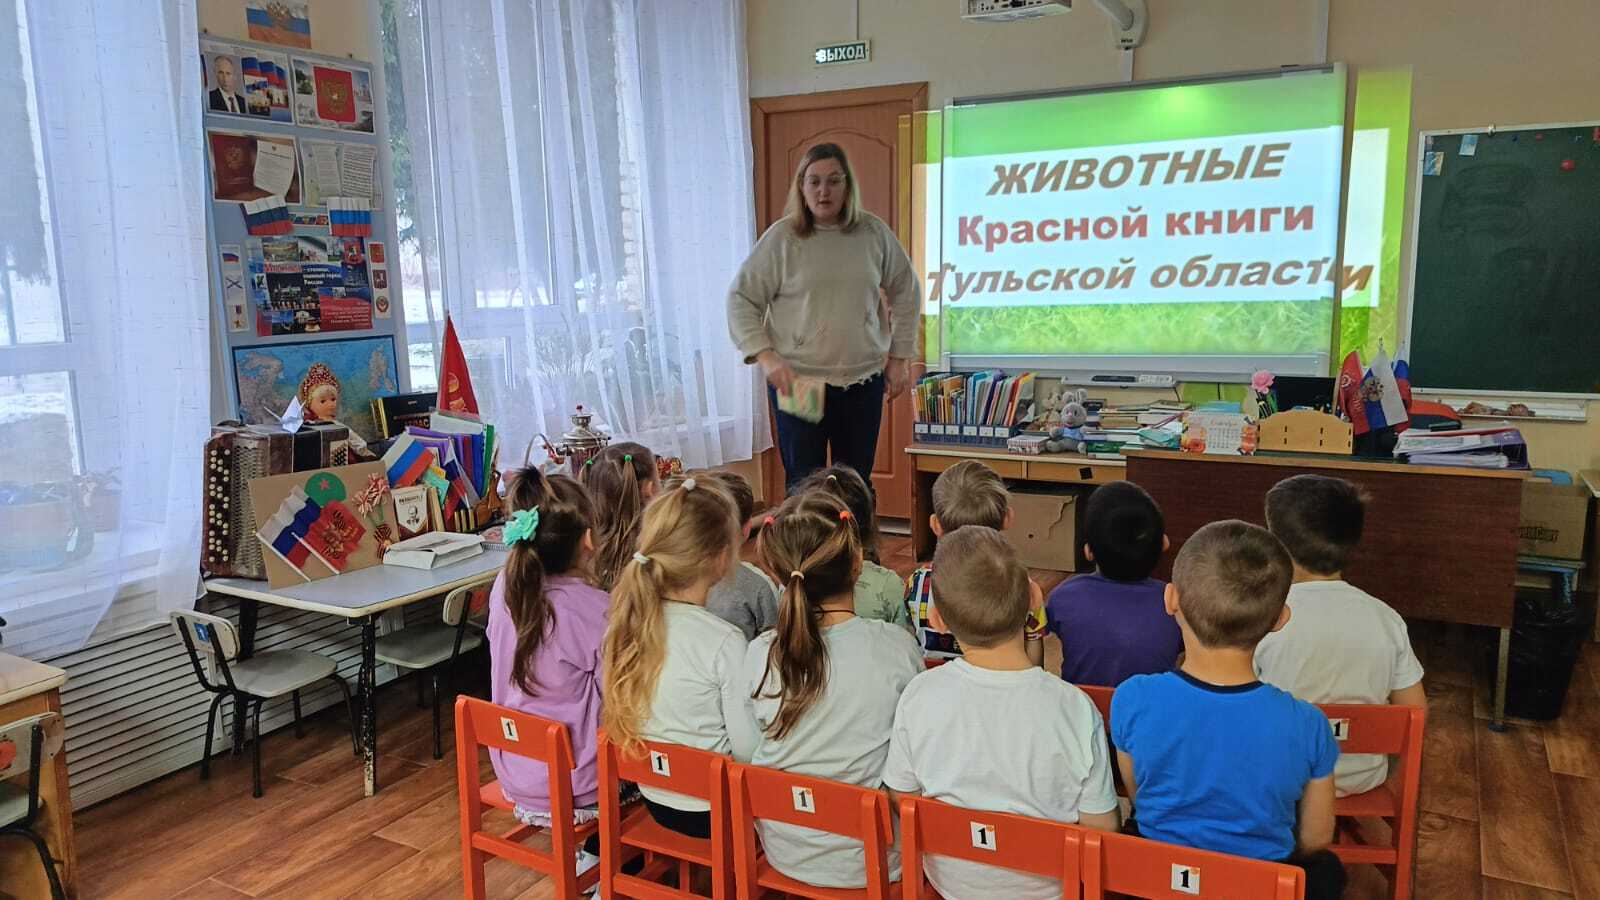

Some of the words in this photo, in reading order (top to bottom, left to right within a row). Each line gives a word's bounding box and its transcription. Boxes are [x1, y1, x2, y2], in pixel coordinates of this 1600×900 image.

[818, 45, 864, 62] ВЫХОД
[986, 142, 1291, 196] ЖИВОТНЫЕ
[958, 206, 1148, 253] Красной
[1165, 205, 1314, 238] книги
[927, 257, 1136, 301] Тульской
[1150, 255, 1374, 292] области
[505, 721, 514, 737] 1
[1334, 721, 1341, 737] 1
[656, 756, 664, 771] 1
[799, 790, 808, 808] 1
[977, 827, 988, 845] 1
[1180, 869, 1190, 888] 1
